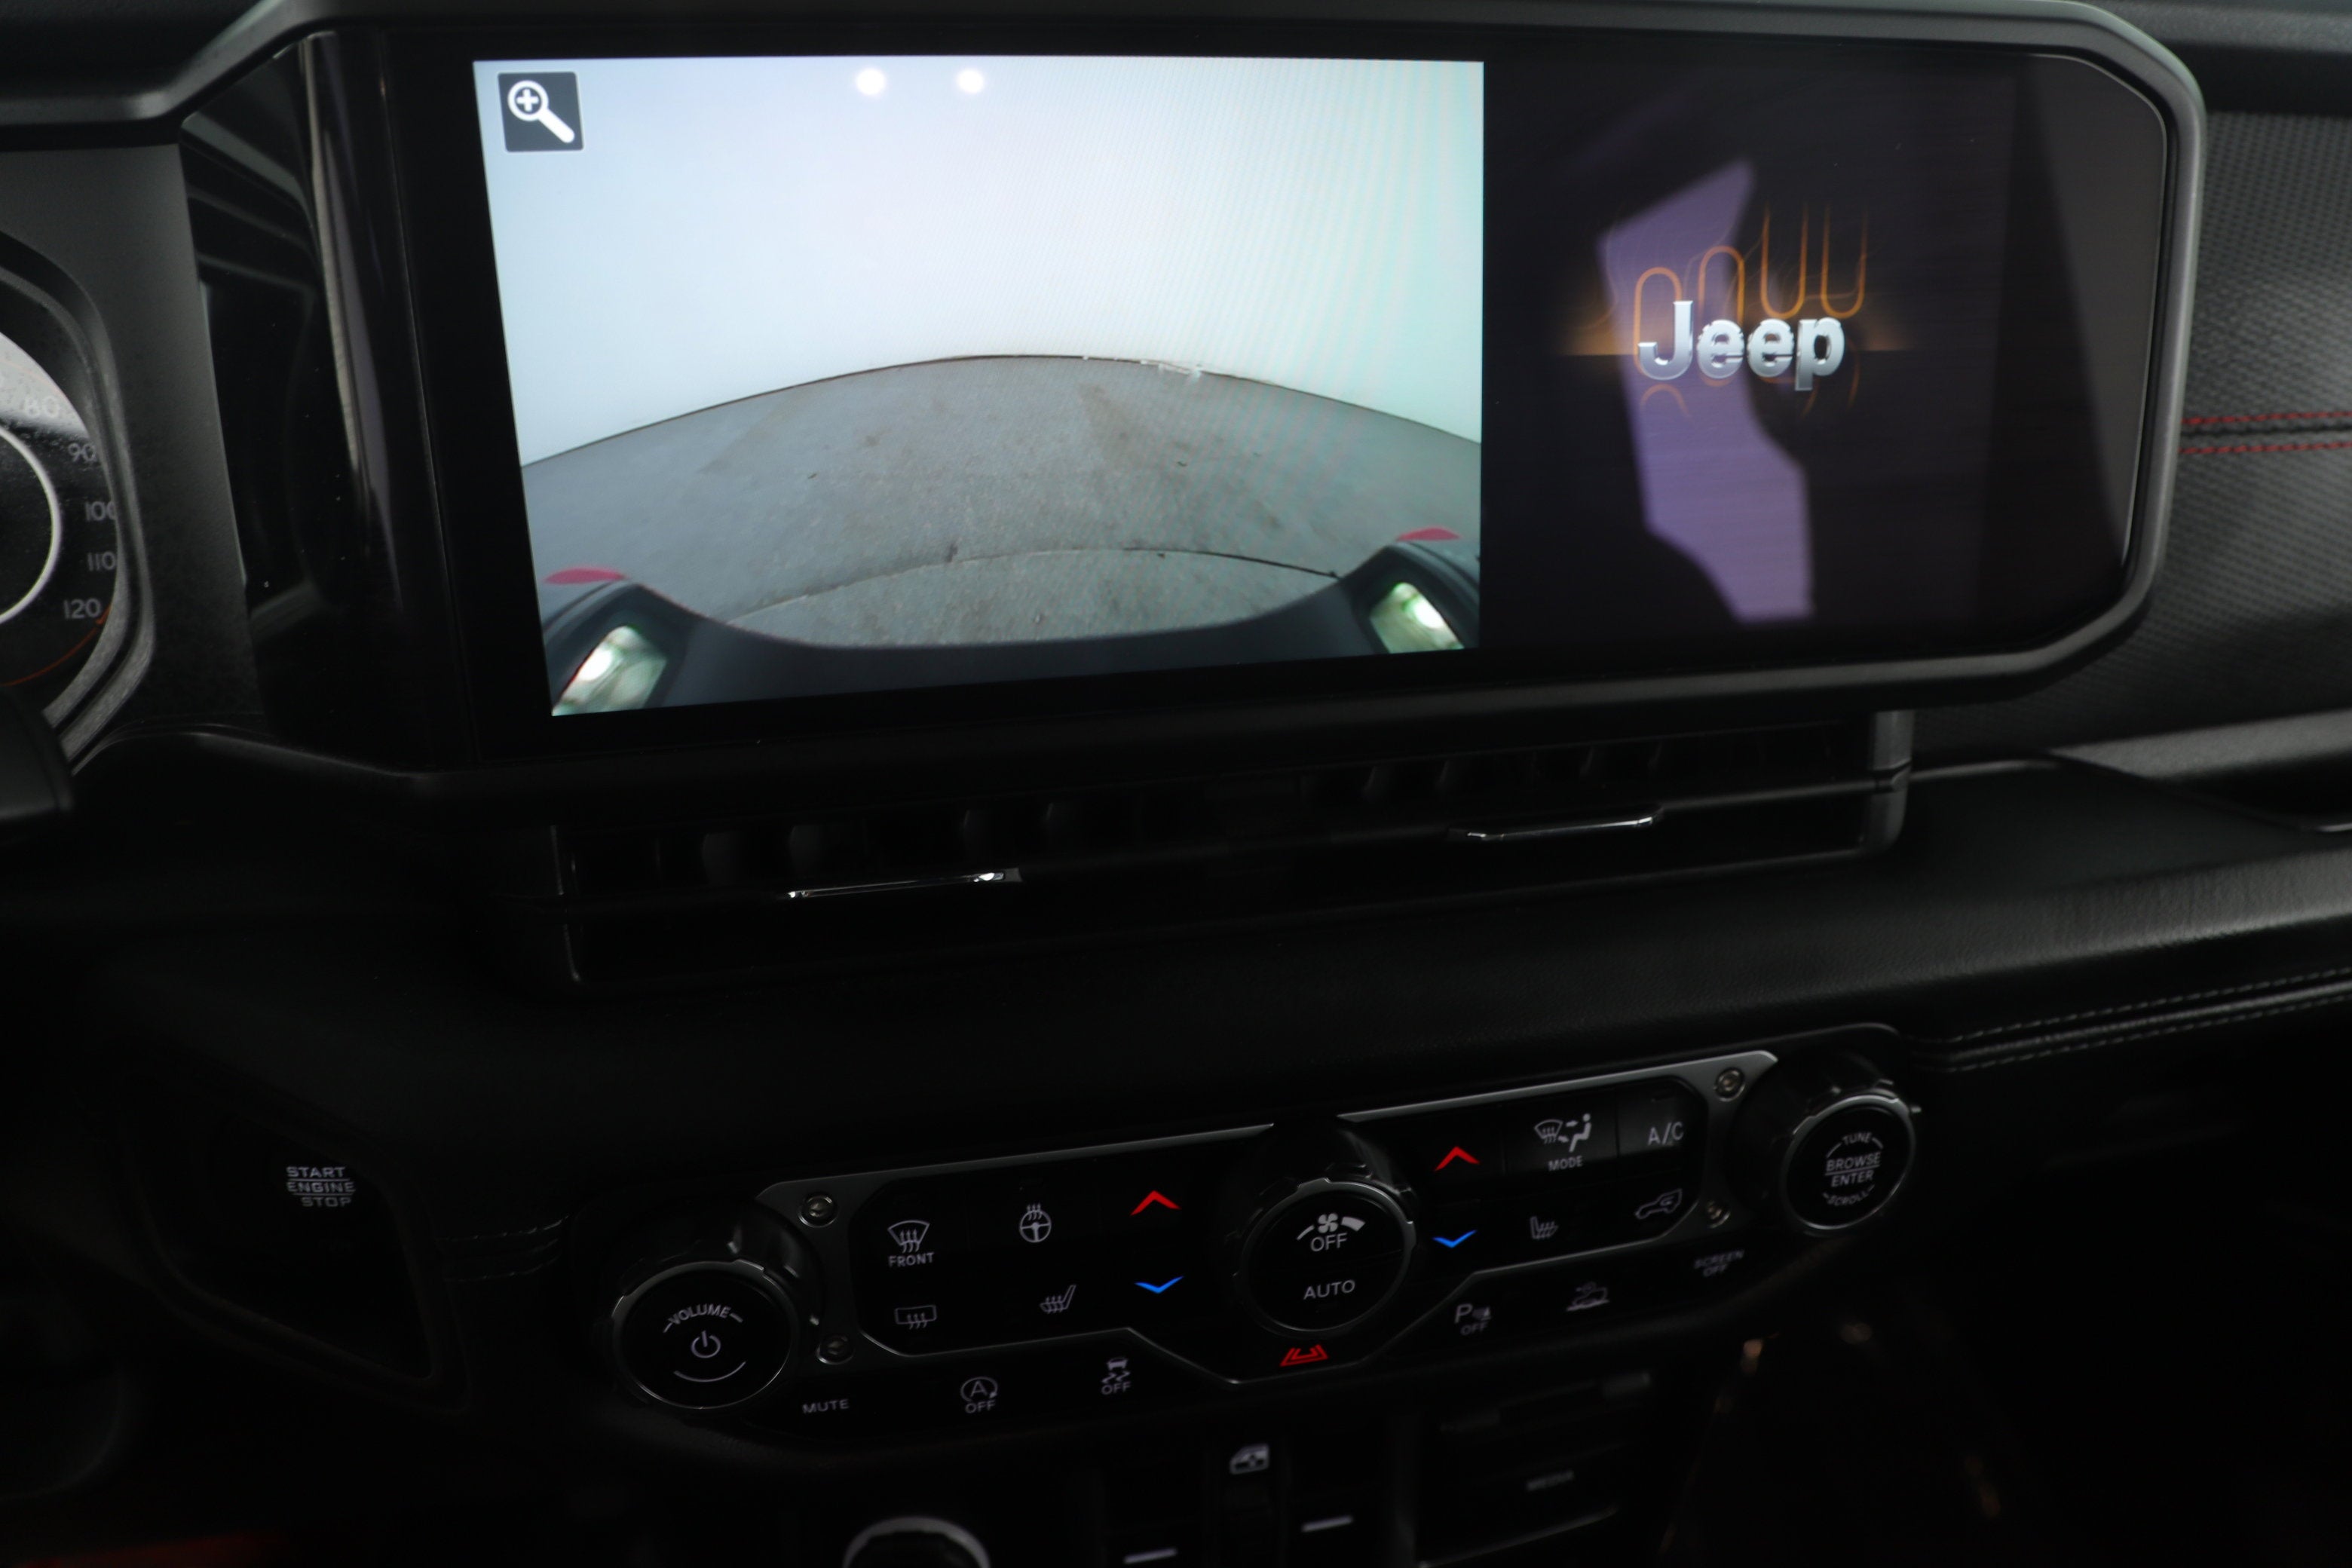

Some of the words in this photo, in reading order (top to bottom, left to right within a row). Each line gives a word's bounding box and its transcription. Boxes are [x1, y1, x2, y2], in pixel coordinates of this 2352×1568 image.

[1637, 300, 1845, 390] Jeep
[68, 443, 96, 463] 90
[87, 551, 116, 571] 110
[63, 598, 102, 620] 120
[1647, 1121, 1684, 1146] A/C
[1842, 1132, 1873, 1145] TUNE
[1548, 1156, 1583, 1171] MODE
[1825, 1151, 1882, 1172] BROWSE
[286, 1165, 346, 1178] START
[1831, 1170, 1874, 1187] ENTER
[286, 1181, 357, 1193] ENGINE
[301, 1196, 353, 1208] STOP
[1309, 1232, 1349, 1252] OFF
[887, 1251, 935, 1267] FRONT
[1303, 1279, 1356, 1301] AUTO
[667, 1303, 732, 1325] VOLUME
[1459, 1322, 1490, 1337] OFF
[1100, 1380, 1132, 1395] OFF
[801, 1398, 850, 1414] MUTE
[964, 1399, 997, 1414] OFF
